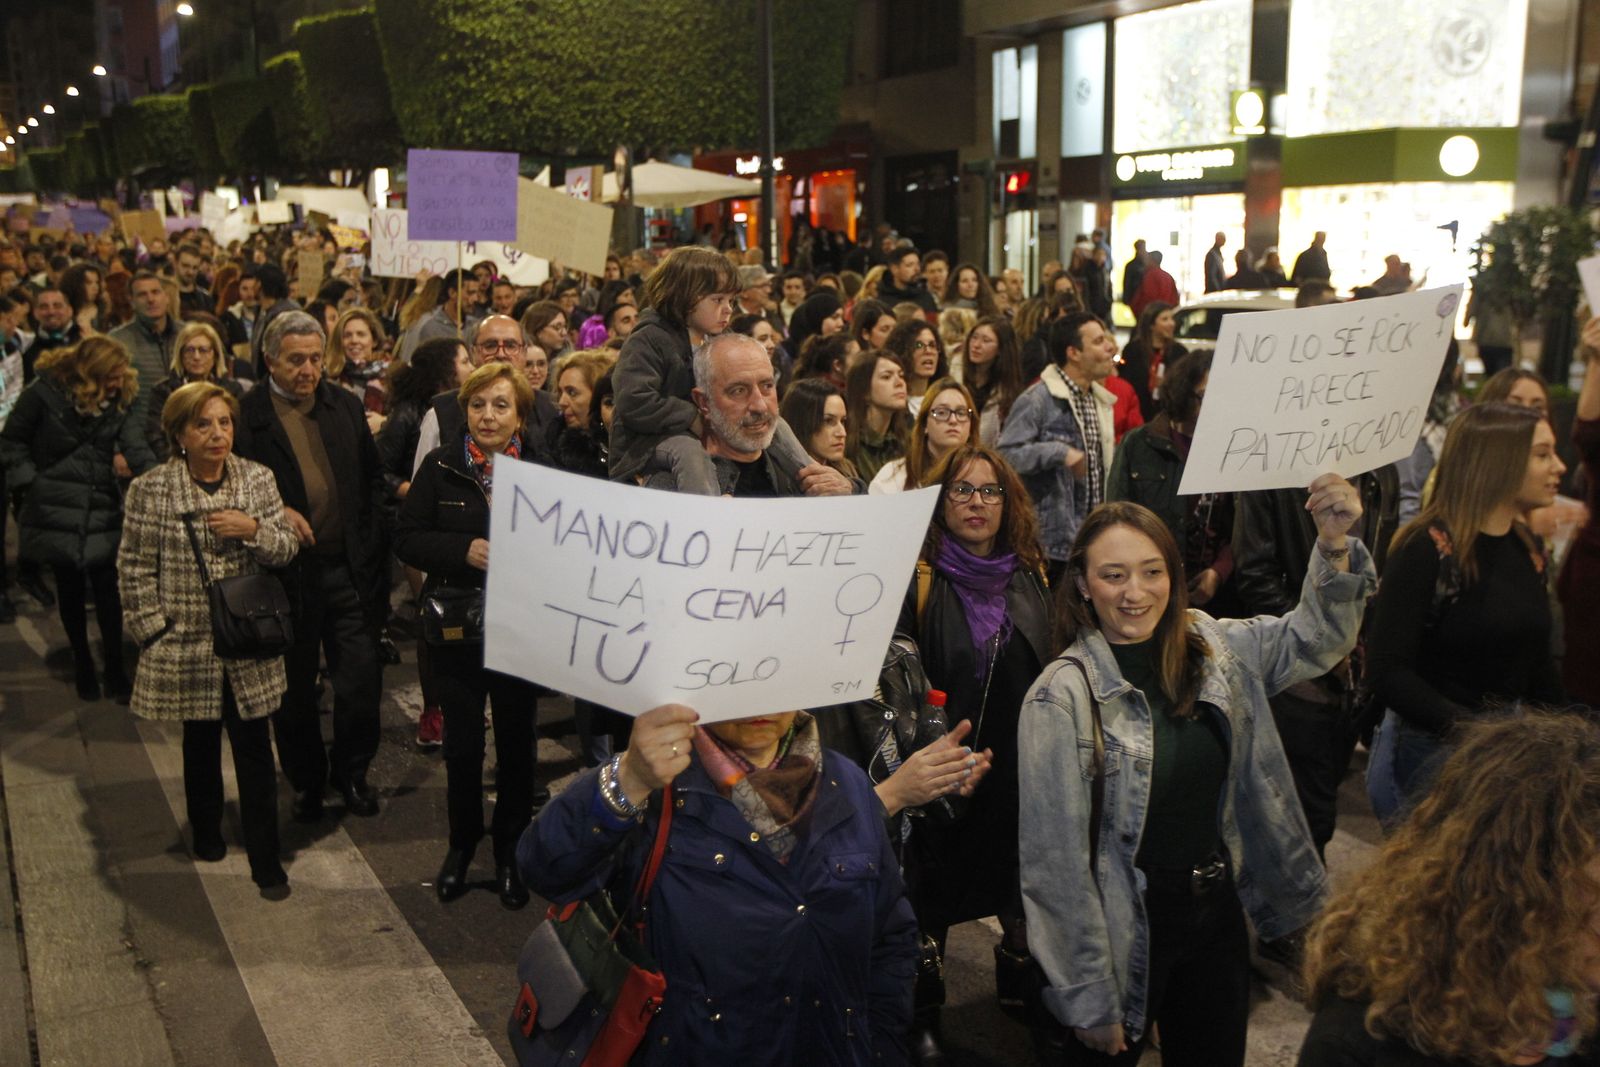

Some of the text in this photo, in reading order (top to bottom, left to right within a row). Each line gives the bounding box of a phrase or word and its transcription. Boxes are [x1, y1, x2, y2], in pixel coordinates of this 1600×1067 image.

[373, 211, 401, 240] NO
[377, 254, 448, 276] MIEDO
[1231, 332, 1277, 366] NO
[1289, 333, 1322, 364] LO
[1328, 316, 1365, 358] SÉ
[1274, 370, 1380, 414] PARECE
[511, 485, 865, 573] MANOLO HAZTE
[587, 566, 786, 622] LA CENA
[544, 603, 781, 691] TÚ SOLO
[831, 680, 862, 695] 8M
